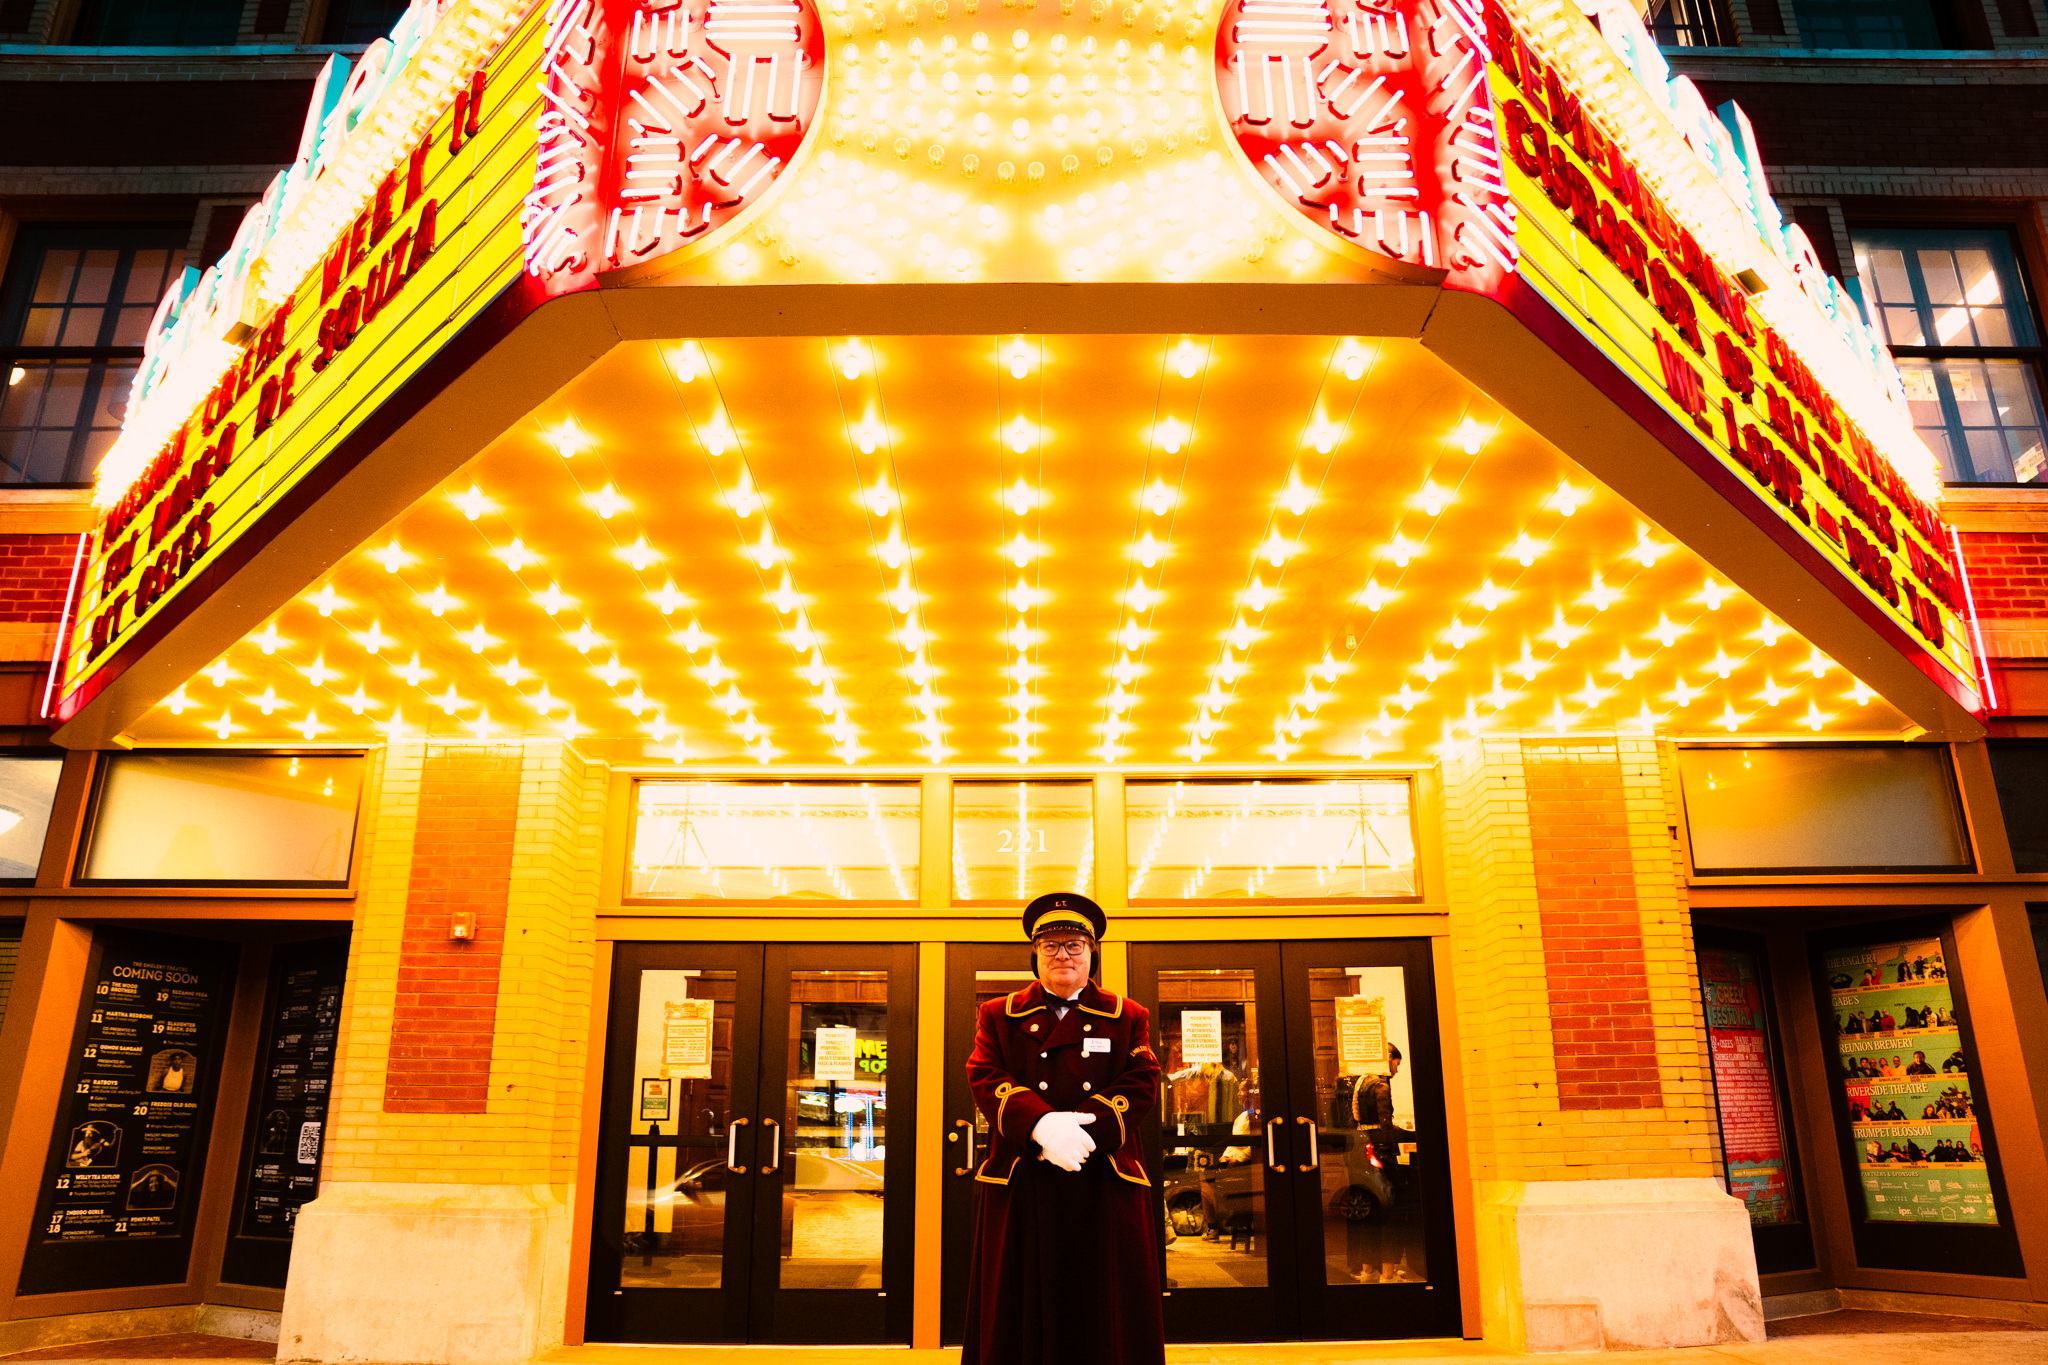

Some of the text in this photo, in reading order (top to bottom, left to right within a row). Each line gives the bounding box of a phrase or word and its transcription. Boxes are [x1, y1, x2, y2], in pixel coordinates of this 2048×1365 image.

[1482, 1, 1757, 348] REMEMBERING
[201, 294, 296, 437] CREEK
[320, 133, 433, 309] WEEK
[253, 348, 301, 440] DE
[312, 198, 438, 373] SOUZA
[1503, 98, 1705, 357] CURATOR
[1714, 330, 1754, 404] OF
[1765, 382, 1820, 475] ALL
[1814, 433, 1898, 553] THINGS
[1763, 326, 1842, 444] CHRIS
[1653, 327, 1714, 440] WE
[1721, 396, 1810, 526] LOVE
[1841, 515, 1900, 609] MISS
[1901, 576, 1945, 650] YOU
[87, 502, 214, 663] SAT OSEES
[996, 829, 1049, 853] 221
[1827, 959, 1842, 968] THE
[1842, 953, 1877, 967] ENGLERT
[112, 965, 199, 984] COMING SOON
[96, 984, 109, 995] 10
[110, 986, 138, 994] BROTHERS
[156, 992, 169, 1002] 19
[1832, 995, 1860, 1007] GABE'S
[90, 1013, 103, 1024] 11
[129, 1012, 153, 1020] REDBONE
[1712, 1006, 1752, 1026] FESTIVAL
[152, 1020, 196, 1034] 19 SLAUGHTER
[1839, 1037, 1913, 1054] REUNION BREWERY
[83, 1048, 97, 1058] 12
[75, 1083, 90, 1094] 12
[1846, 1082, 1928, 1097] RIVERSIDE THEATRE
[132, 1106, 148, 1116] 20
[1852, 1125, 1932, 1138] TRUMPET BLOSSOM
[55, 1178, 70, 1189] 12
[51, 1215, 64, 1224] 17
[114, 1222, 127, 1233] 21
